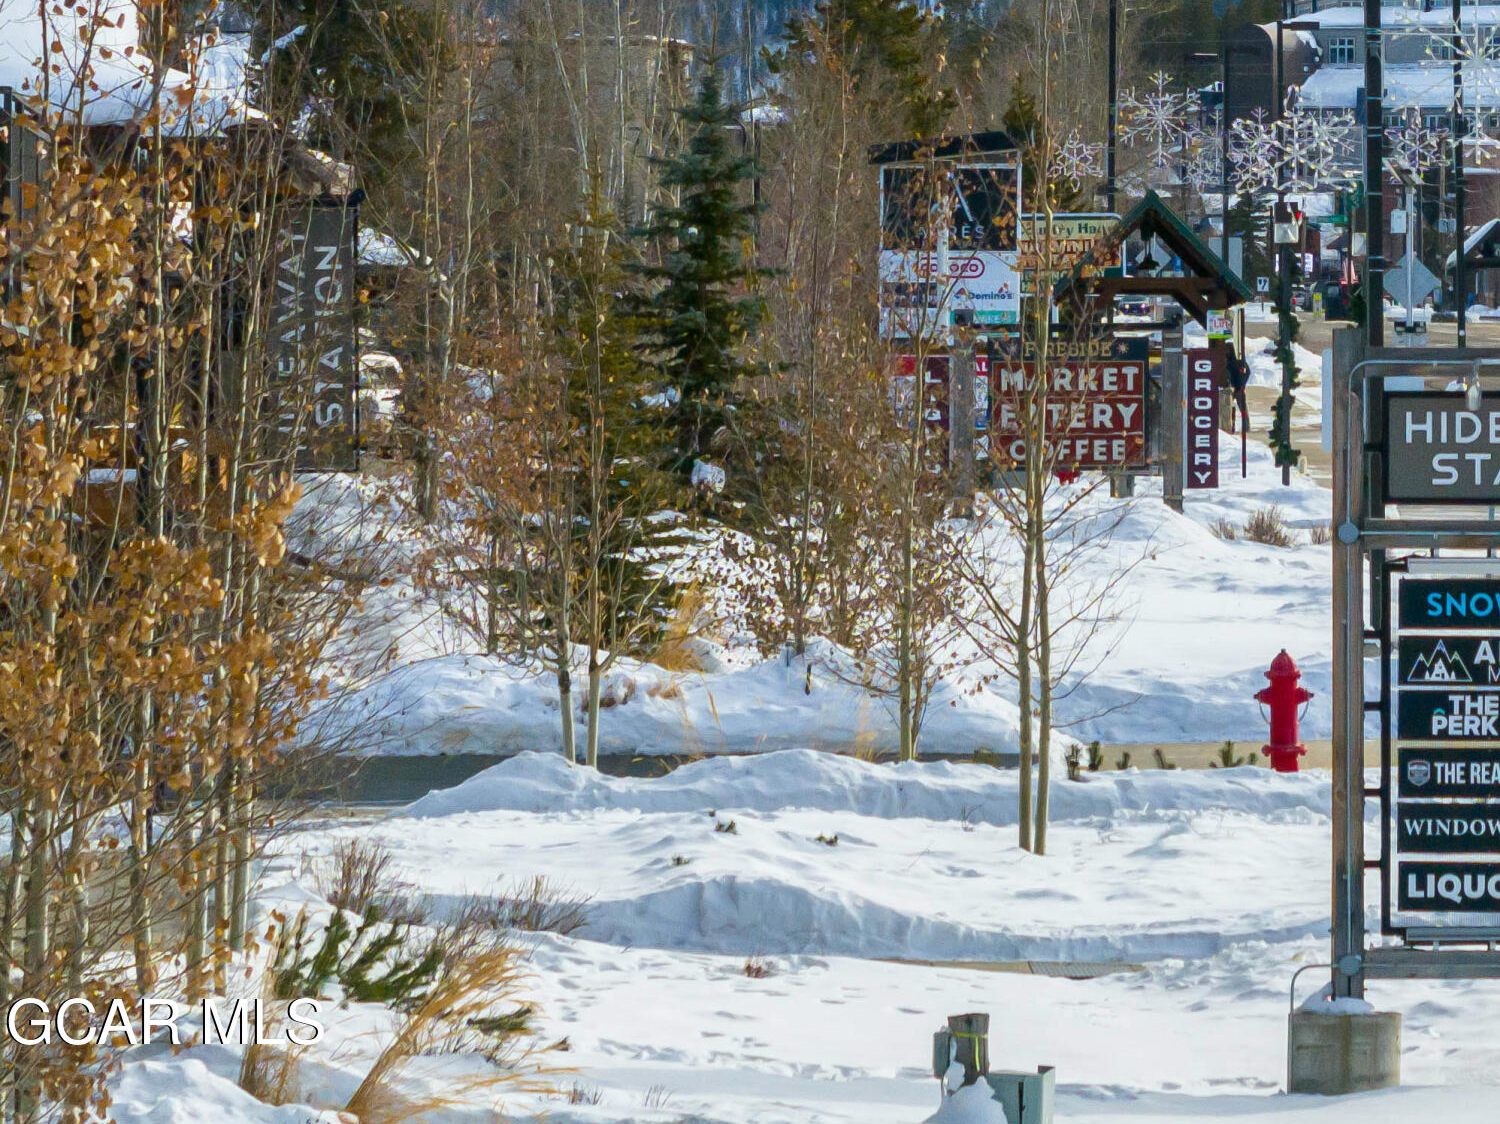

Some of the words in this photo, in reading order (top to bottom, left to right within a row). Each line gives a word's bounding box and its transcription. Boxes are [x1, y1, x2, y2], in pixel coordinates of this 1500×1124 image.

[1193, 359, 1212, 485] GROCERY
[1449, 694, 1497, 714] THE
[1432, 714, 1496, 735] PERK
[1434, 761, 1464, 783] THE
